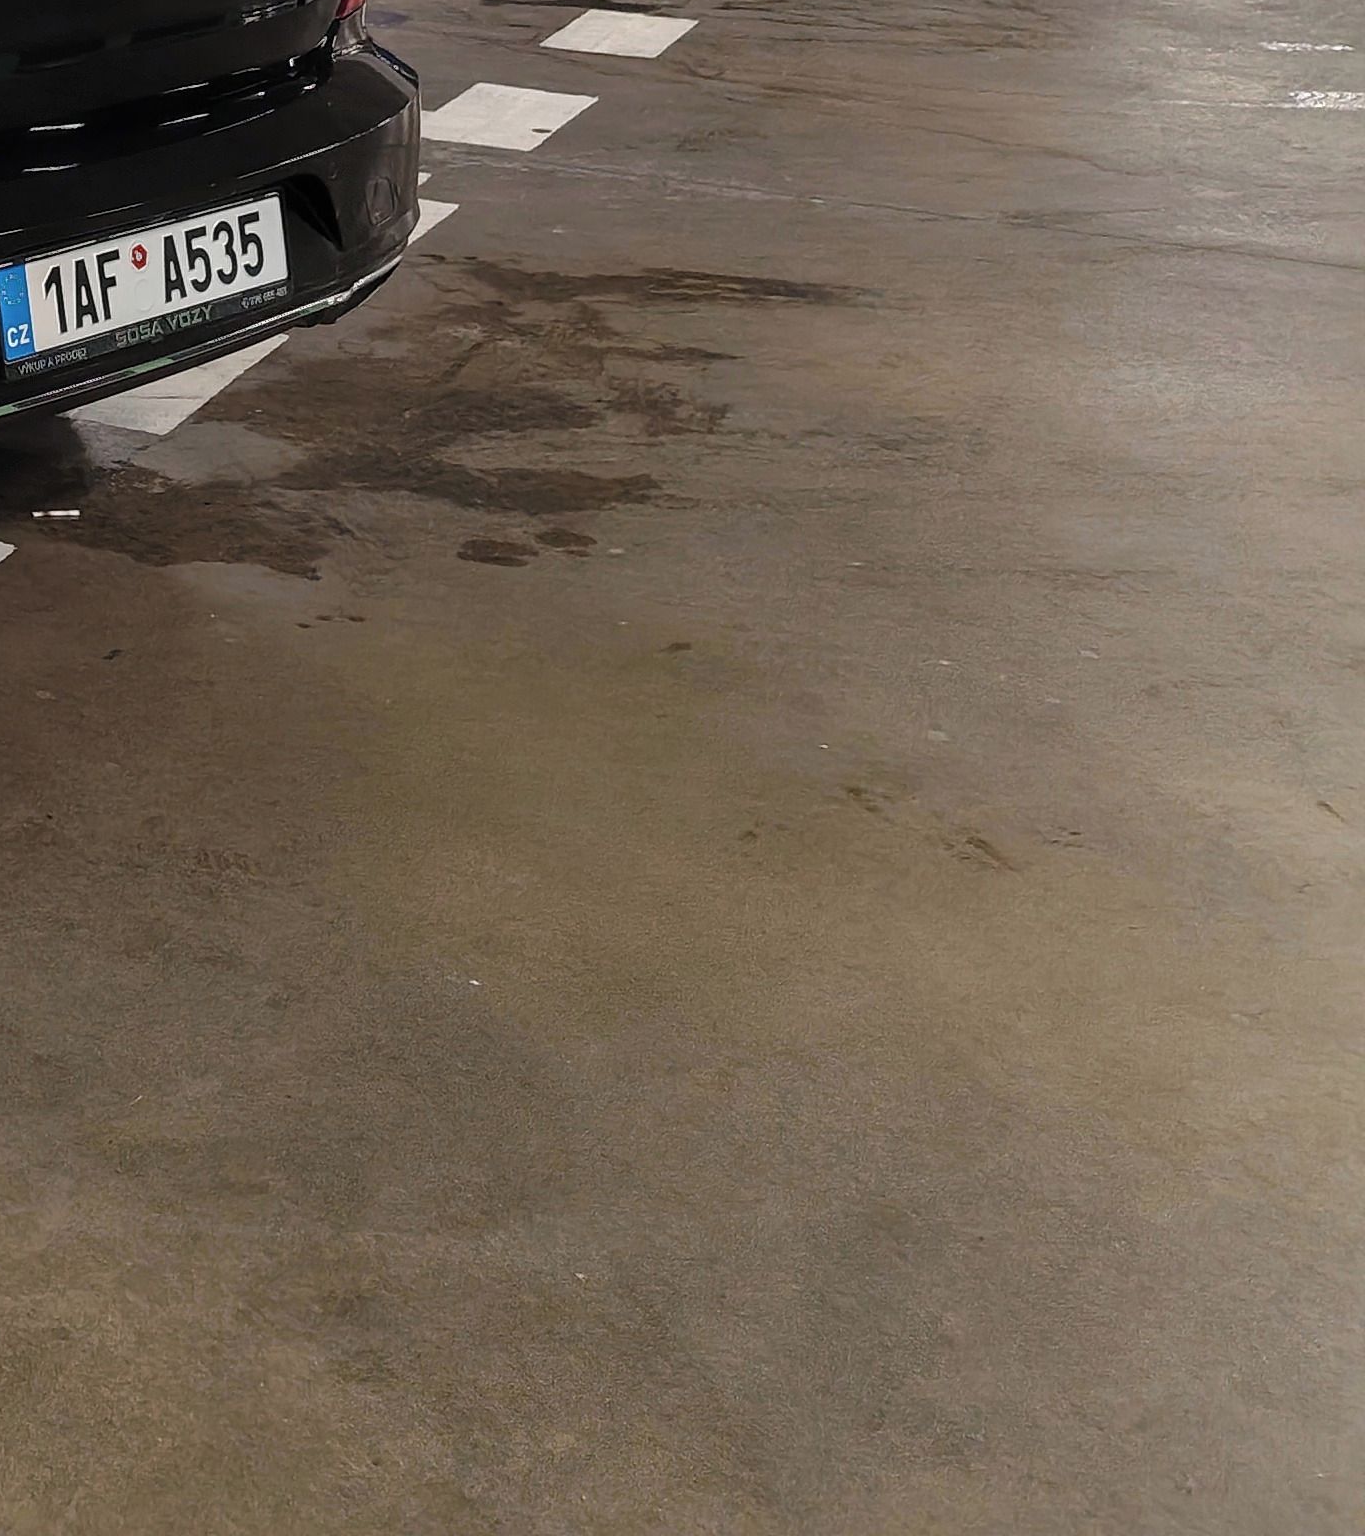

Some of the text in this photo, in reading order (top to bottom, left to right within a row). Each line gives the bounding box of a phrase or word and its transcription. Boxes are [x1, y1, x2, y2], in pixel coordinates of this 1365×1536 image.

[43, 210, 265, 335] 1AF A535
[166, 304, 213, 332] VOZY
[7, 324, 31, 348] CZ
